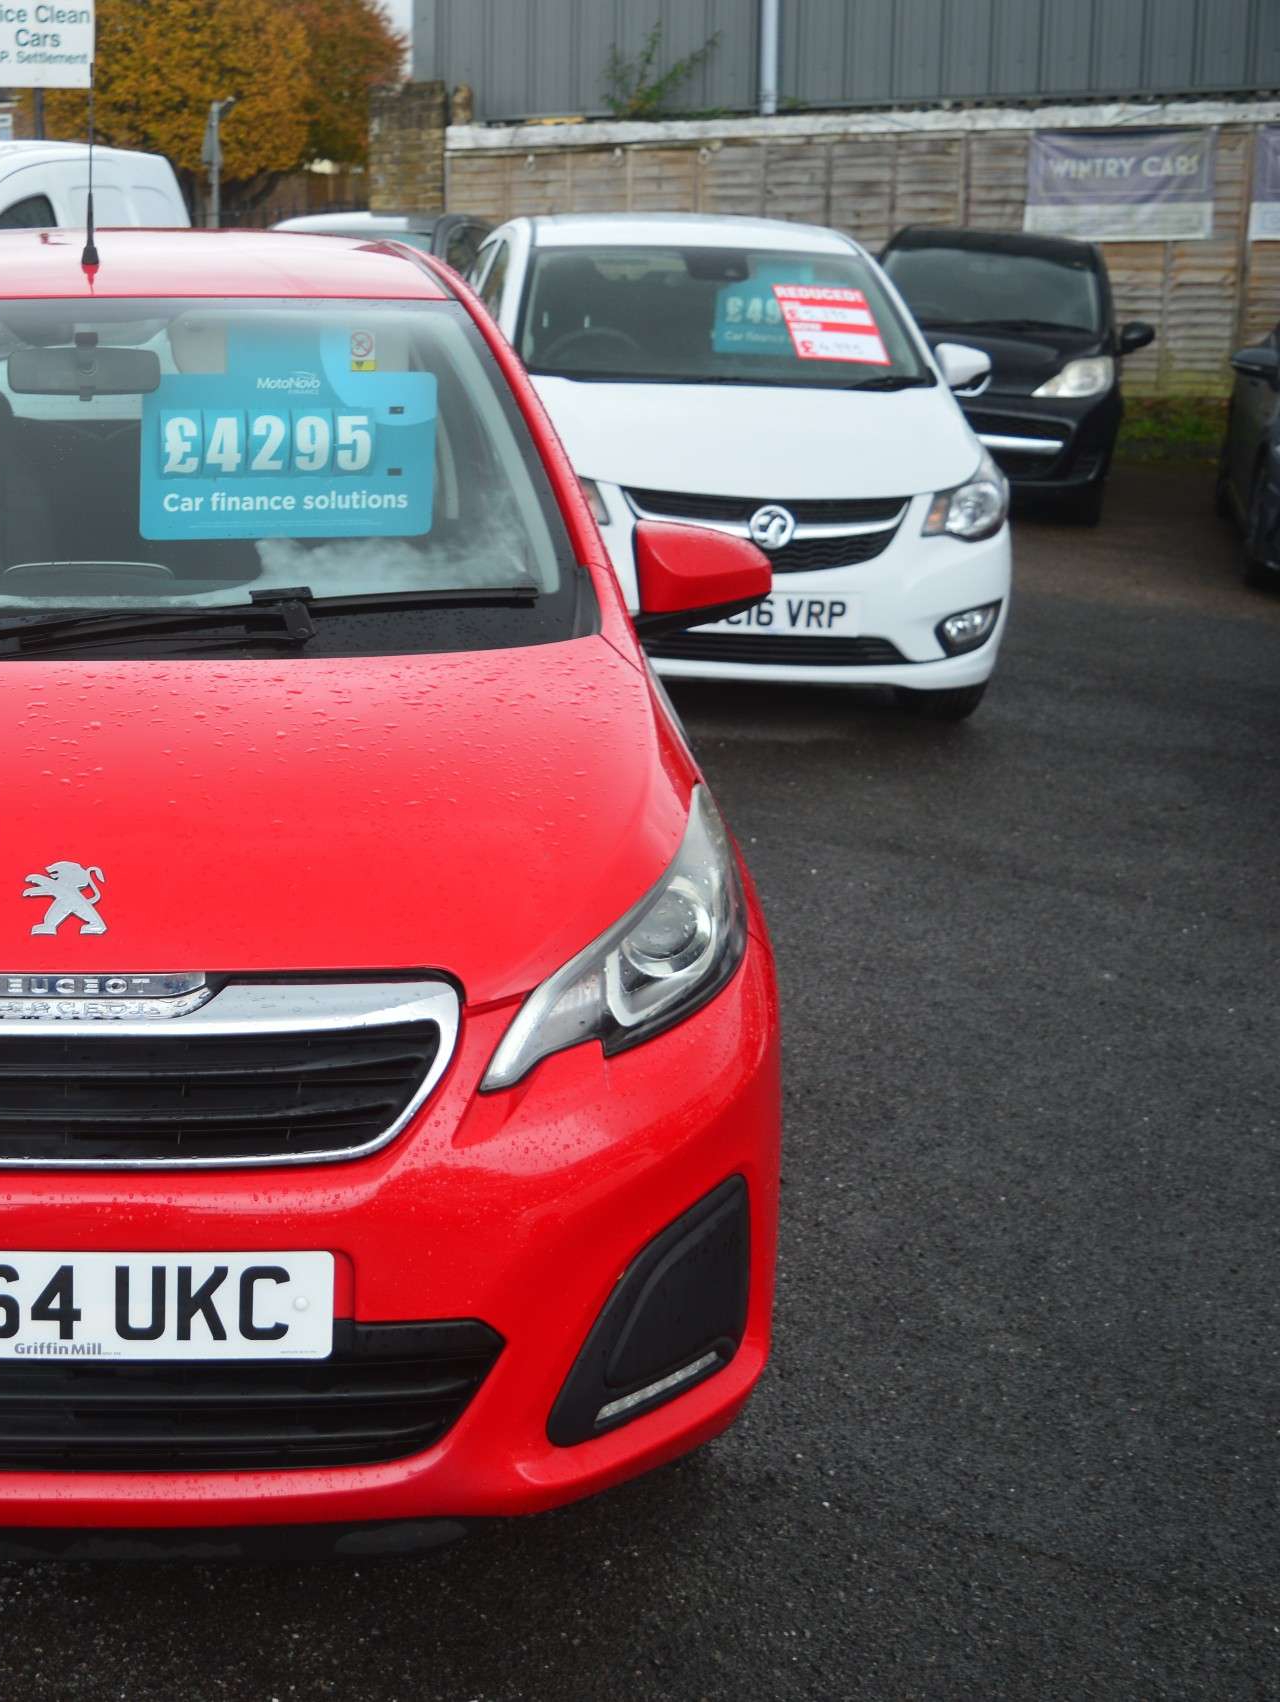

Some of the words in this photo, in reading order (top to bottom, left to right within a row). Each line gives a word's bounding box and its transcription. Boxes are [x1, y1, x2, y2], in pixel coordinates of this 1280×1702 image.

[35, 4, 90, 24] Clean
[15, 29, 61, 48] Cars
[16, 51, 88, 65] Settlement
[1048, 156, 1138, 179] WINTRY
[1141, 154, 1200, 177] CARS
[726, 297, 782, 325] £49
[163, 414, 373, 474] £4295
[163, 493, 204, 512] Car
[211, 491, 296, 511] finance
[303, 489, 409, 510] solutions
[787, 599, 847, 628] VRP
[115, 1264, 292, 1342] UKC
